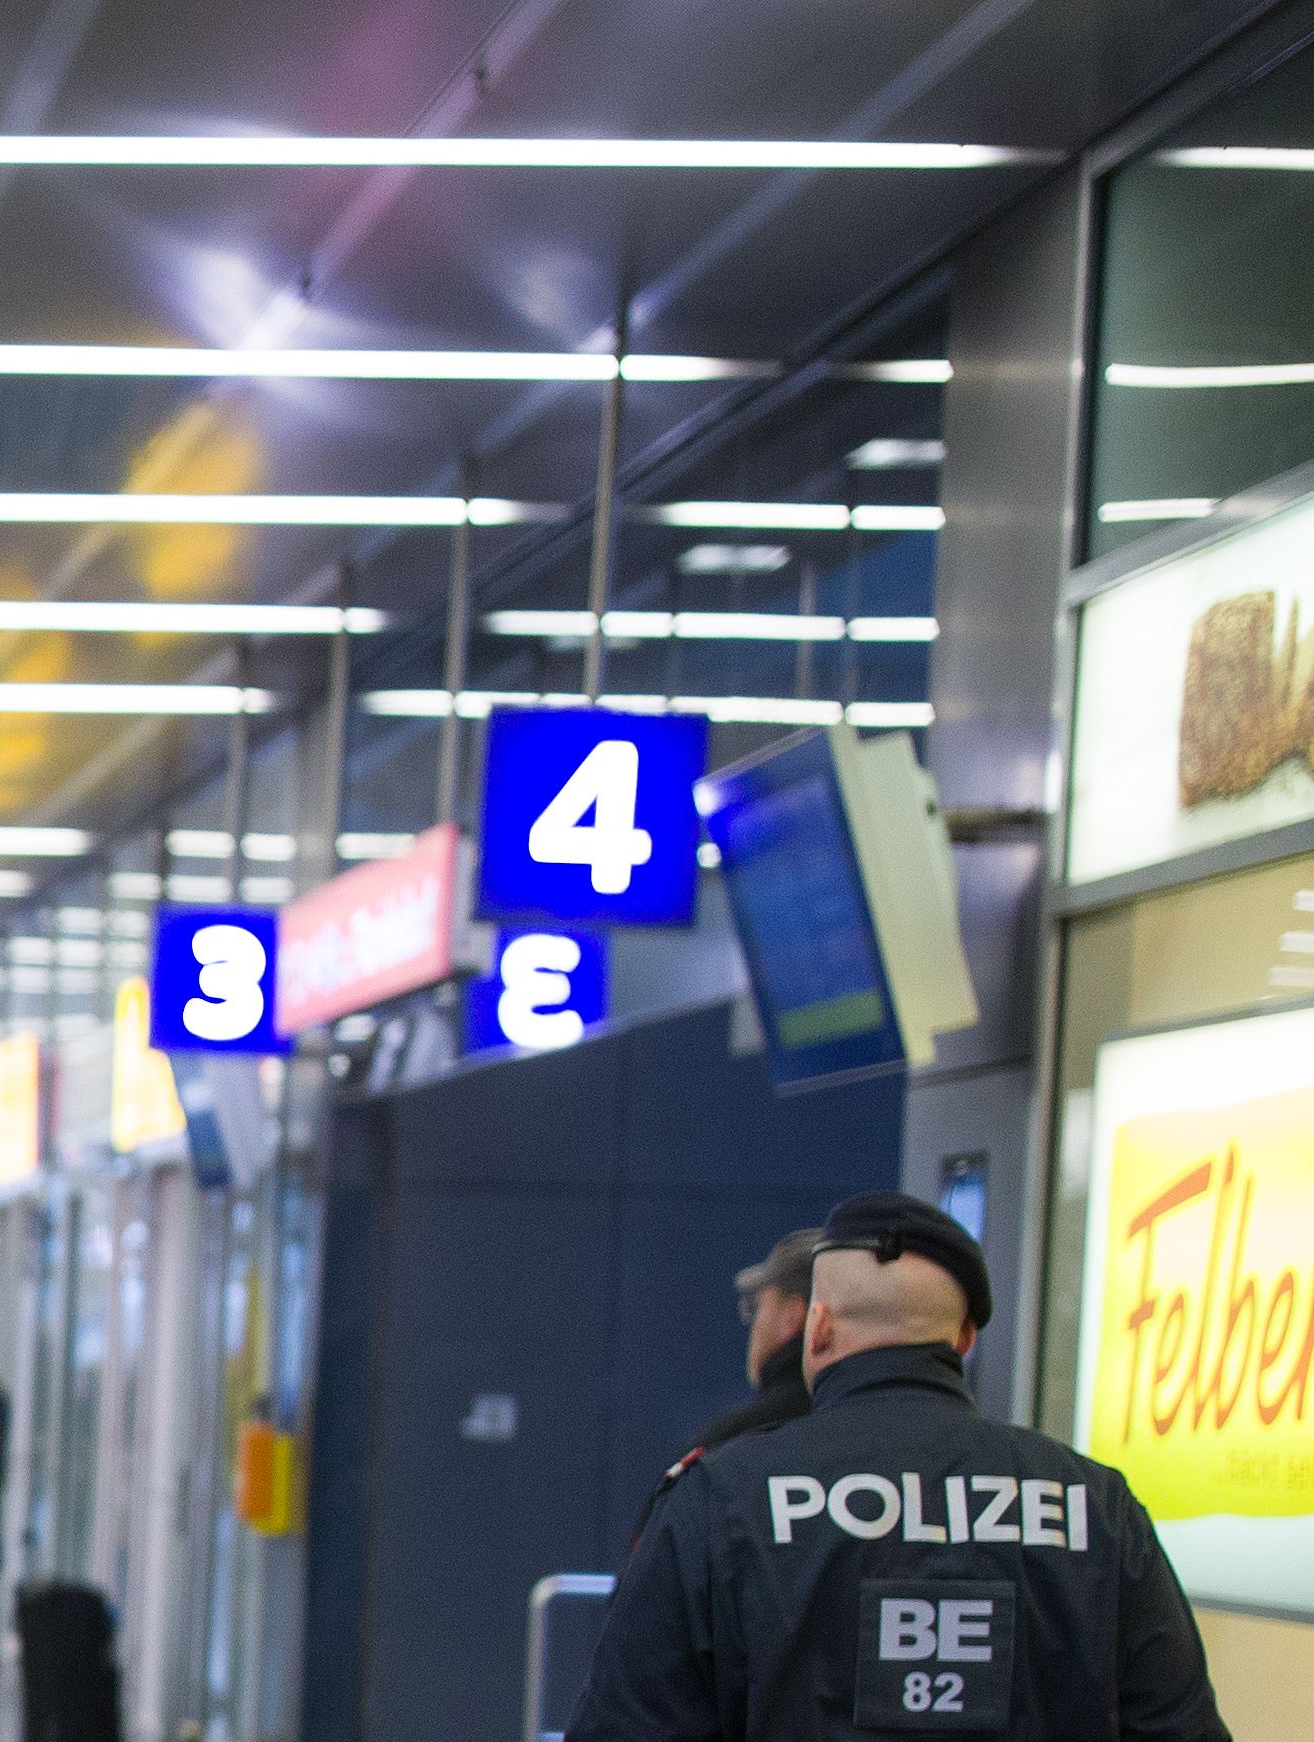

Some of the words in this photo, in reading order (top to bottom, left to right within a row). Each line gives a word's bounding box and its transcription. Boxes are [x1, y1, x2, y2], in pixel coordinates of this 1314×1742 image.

[528, 740, 652, 894] 4
[182, 925, 267, 1041] 3
[768, 1472, 1088, 1551] POLIZEI
[878, 1598, 993, 1662] BE
[902, 1671, 964, 1713] 82
